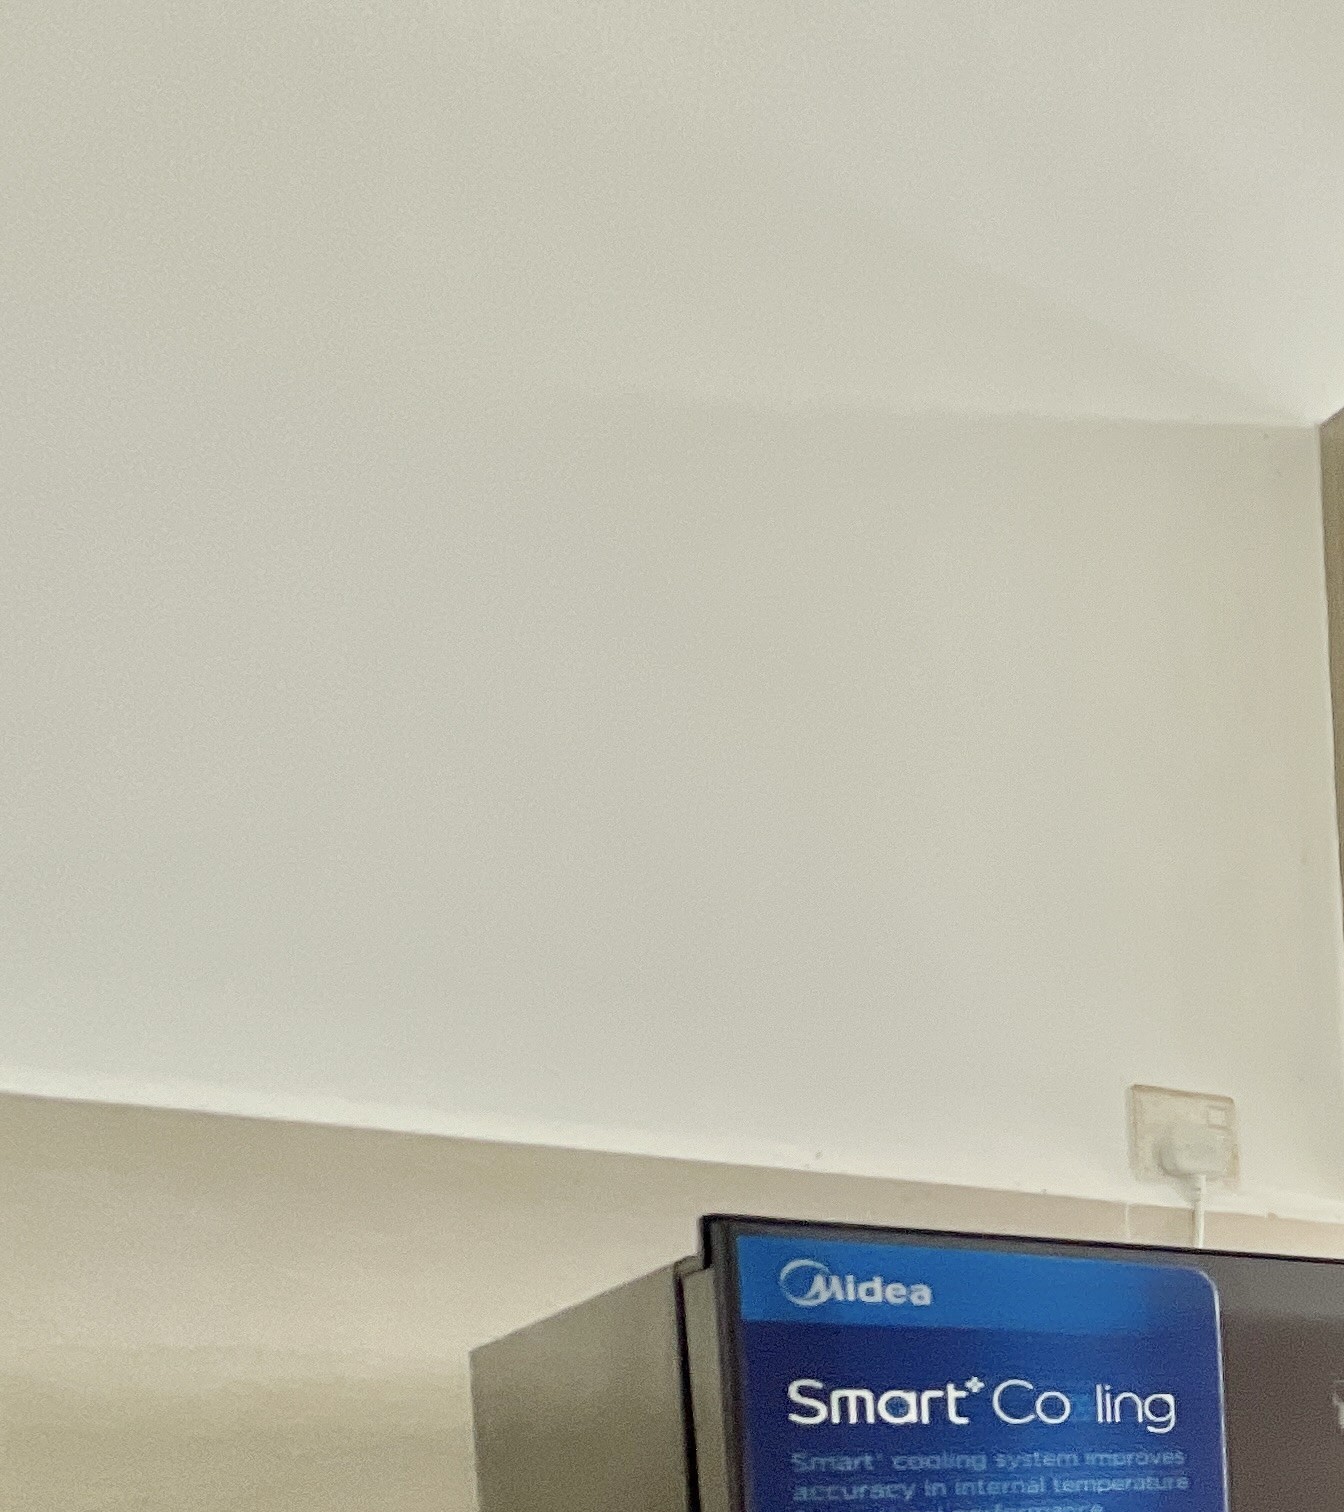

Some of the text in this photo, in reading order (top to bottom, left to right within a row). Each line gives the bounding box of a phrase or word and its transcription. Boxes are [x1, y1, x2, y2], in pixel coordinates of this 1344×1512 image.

[780, 1259, 933, 1307] Midea
[891, 1449, 988, 1473] cooling
[995, 1451, 1078, 1472] system
[1084, 1448, 1186, 1470] improves
[792, 1474, 1190, 1503] accuracy in internal temperature
